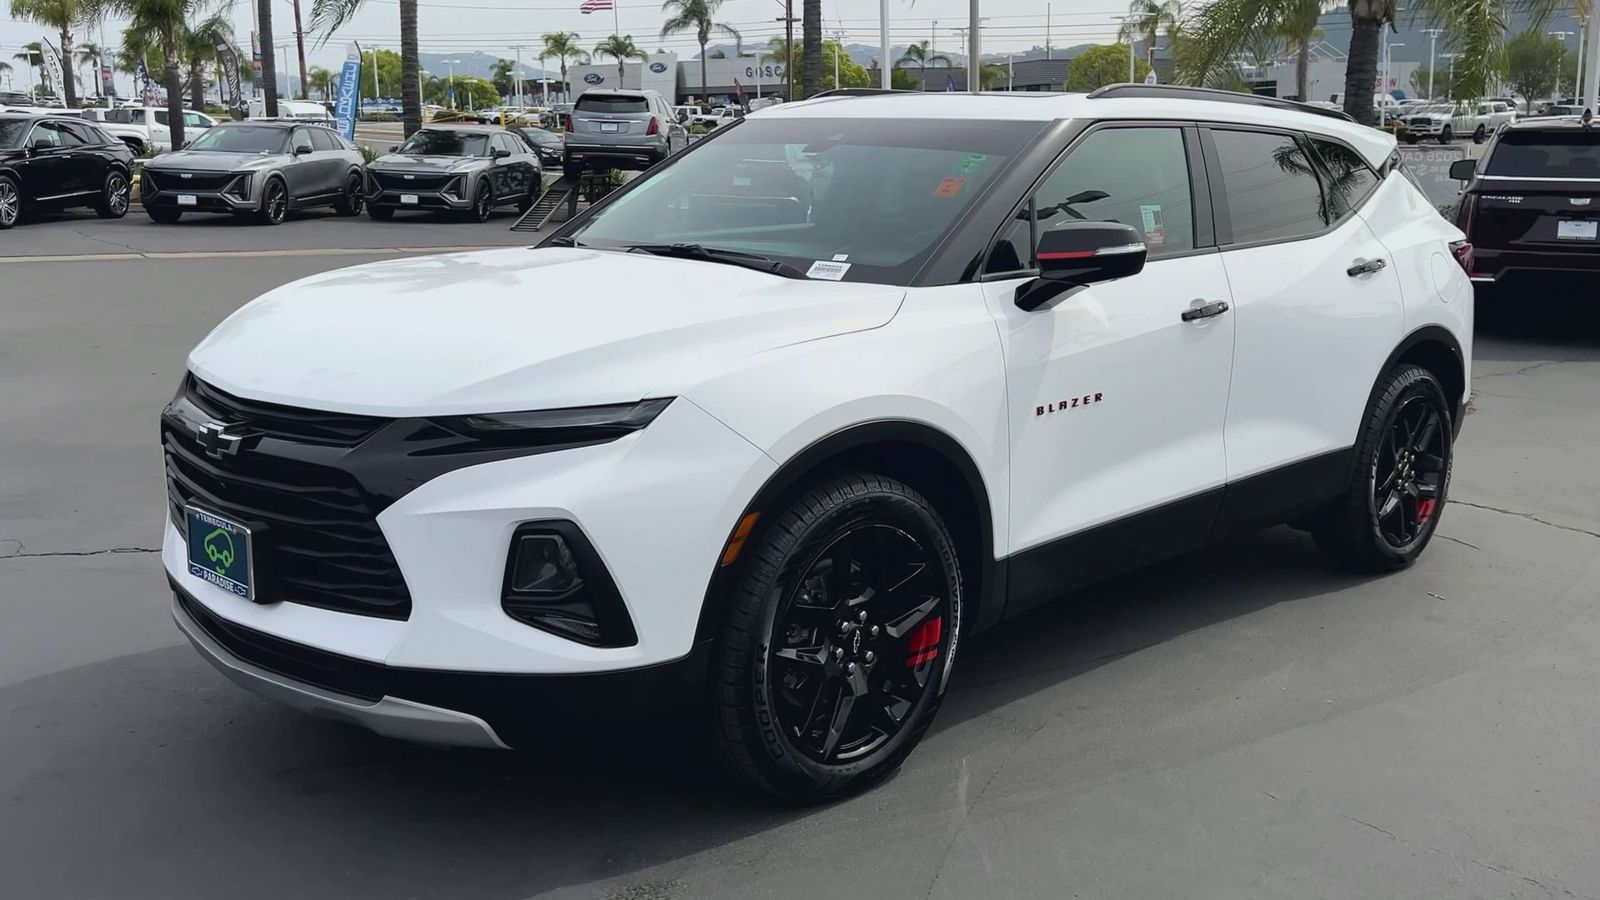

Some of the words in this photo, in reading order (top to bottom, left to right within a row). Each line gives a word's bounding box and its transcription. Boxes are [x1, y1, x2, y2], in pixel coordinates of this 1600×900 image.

[1036, 392, 1103, 416] BLAZER
[200, 513, 234, 533] TEMECULA
[203, 571, 235, 592] PARADISE
